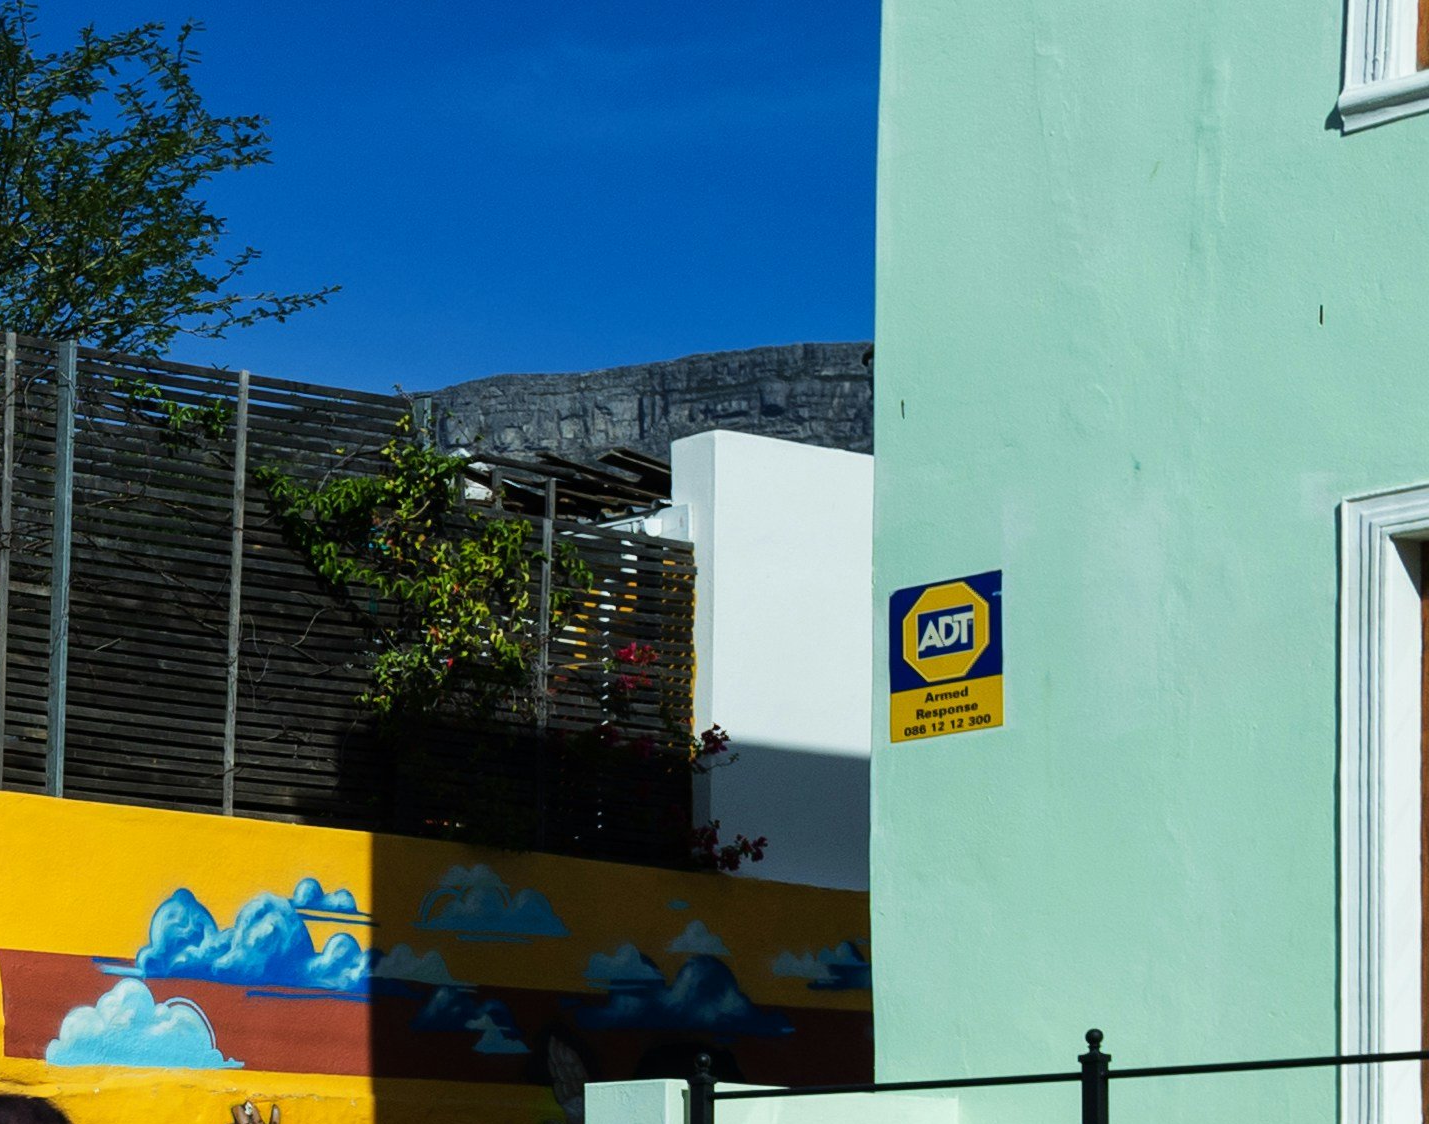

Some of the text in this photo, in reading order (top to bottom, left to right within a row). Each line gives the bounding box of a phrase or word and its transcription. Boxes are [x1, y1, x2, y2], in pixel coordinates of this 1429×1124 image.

[918, 611, 974, 652] ADT
[924, 686, 969, 704] Armed
[916, 702, 979, 720] Response
[904, 713, 992, 737] 086 12 12 300
